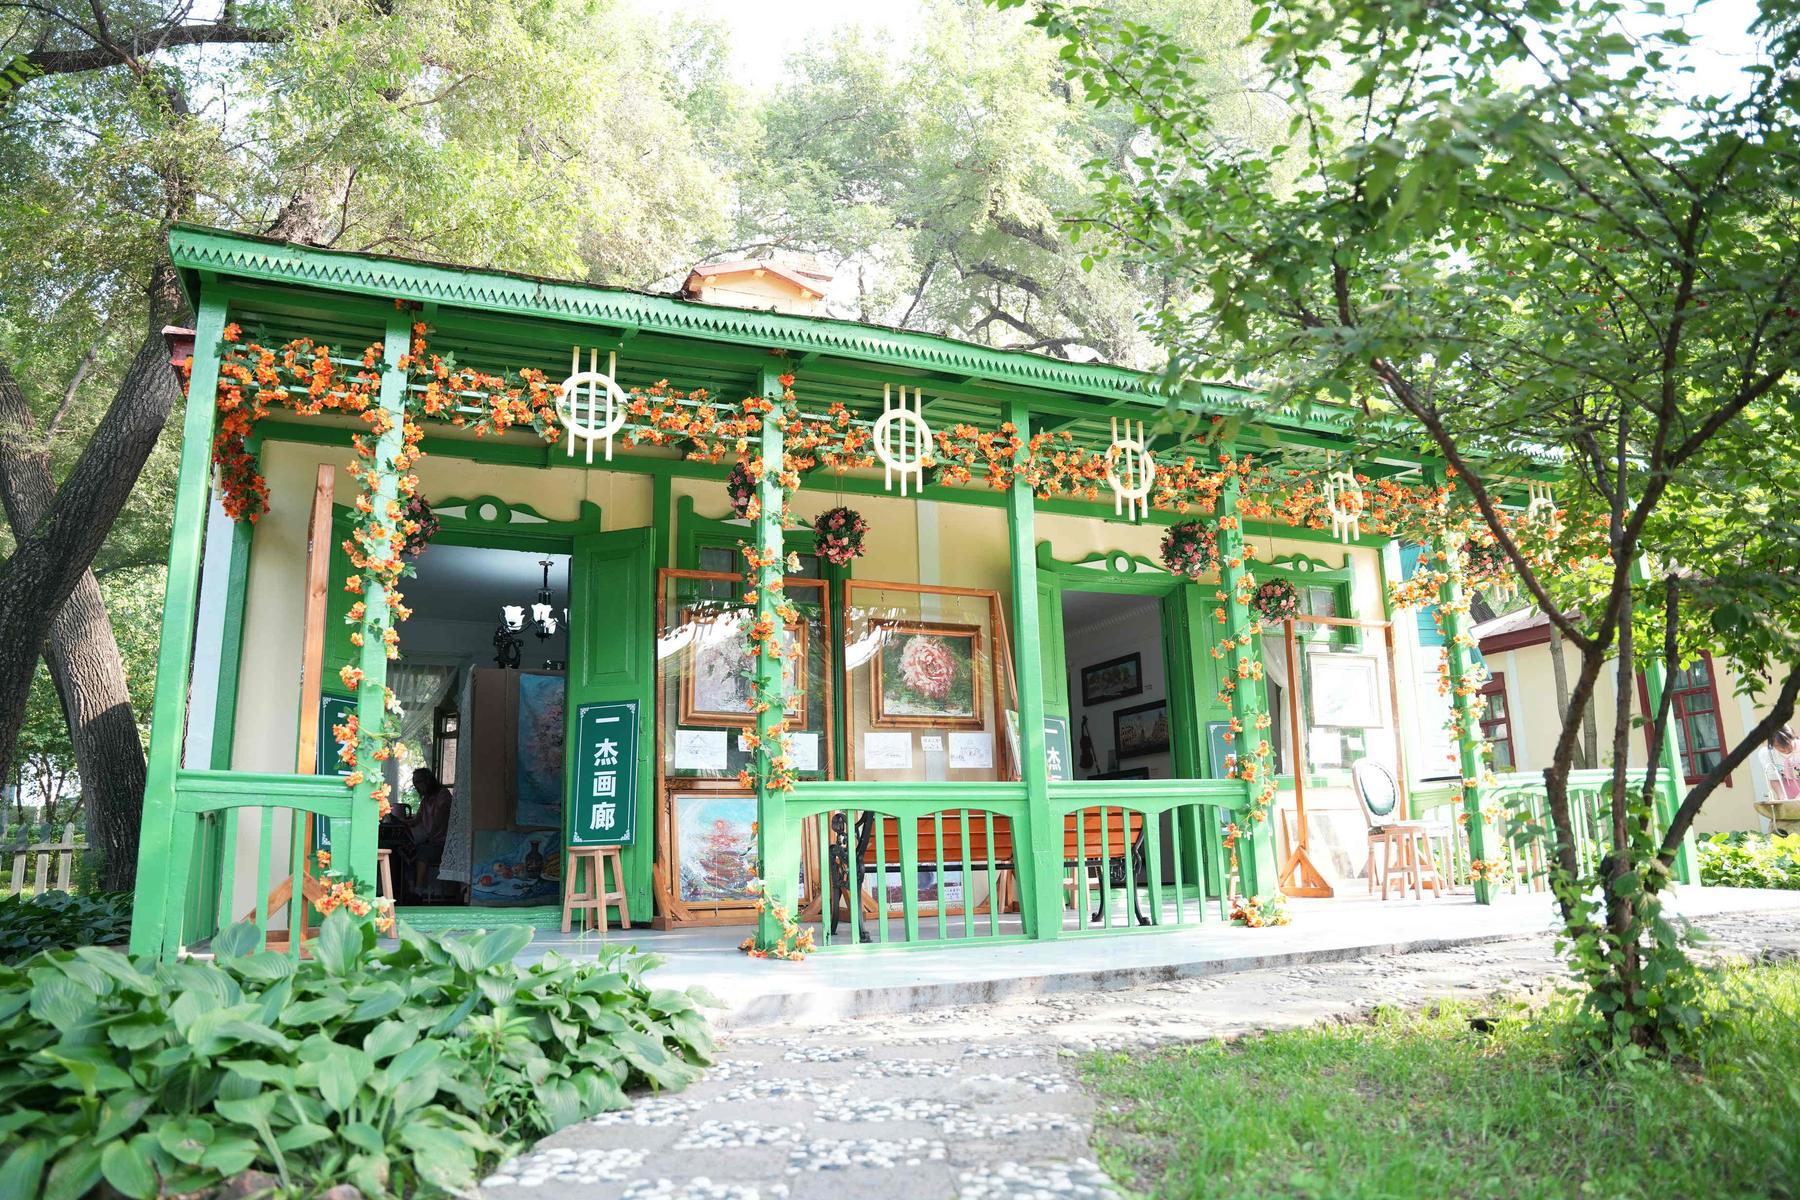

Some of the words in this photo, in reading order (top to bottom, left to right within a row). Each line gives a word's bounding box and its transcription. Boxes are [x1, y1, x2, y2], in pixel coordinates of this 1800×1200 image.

[589, 716, 620, 831] 一杰画廊
[1044, 728, 1062, 780] 一杰
